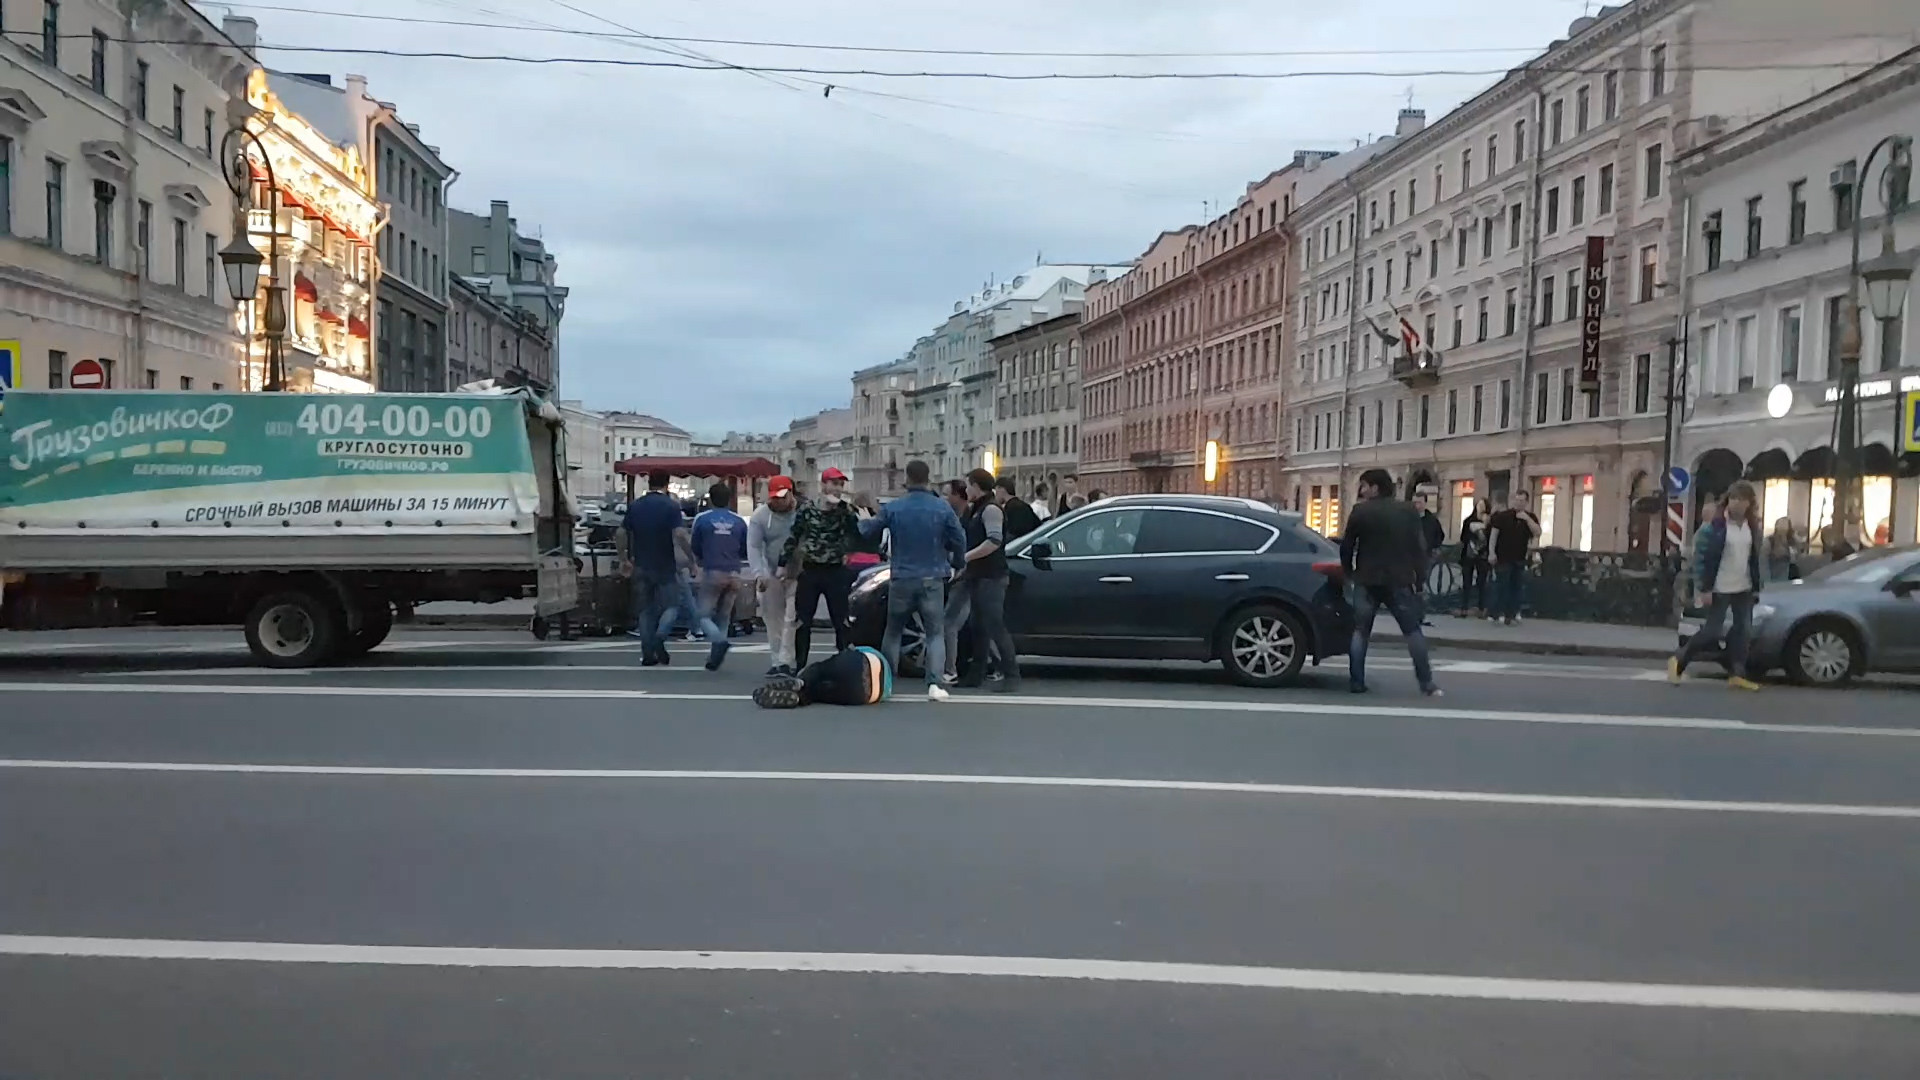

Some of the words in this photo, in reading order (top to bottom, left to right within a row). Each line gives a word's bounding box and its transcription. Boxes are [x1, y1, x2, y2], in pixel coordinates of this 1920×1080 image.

[1583, 266, 1602, 371] КОНСУЛ
[296, 403, 492, 438] 404-00-00
[324, 440, 464, 456] КРУГЛОСУТОЧНО
[197, 464, 208, 476] И
[210, 464, 263, 477] БЫСТРО
[185, 501, 264, 522] СРОЧНЫЙ
[267, 499, 322, 517] ВЫЗОВ
[326, 497, 402, 513] МАШИНЫ
[406, 497, 426, 511] ЗА
[432, 497, 449, 511] 15
[452, 497, 509, 511] МИНУТ
